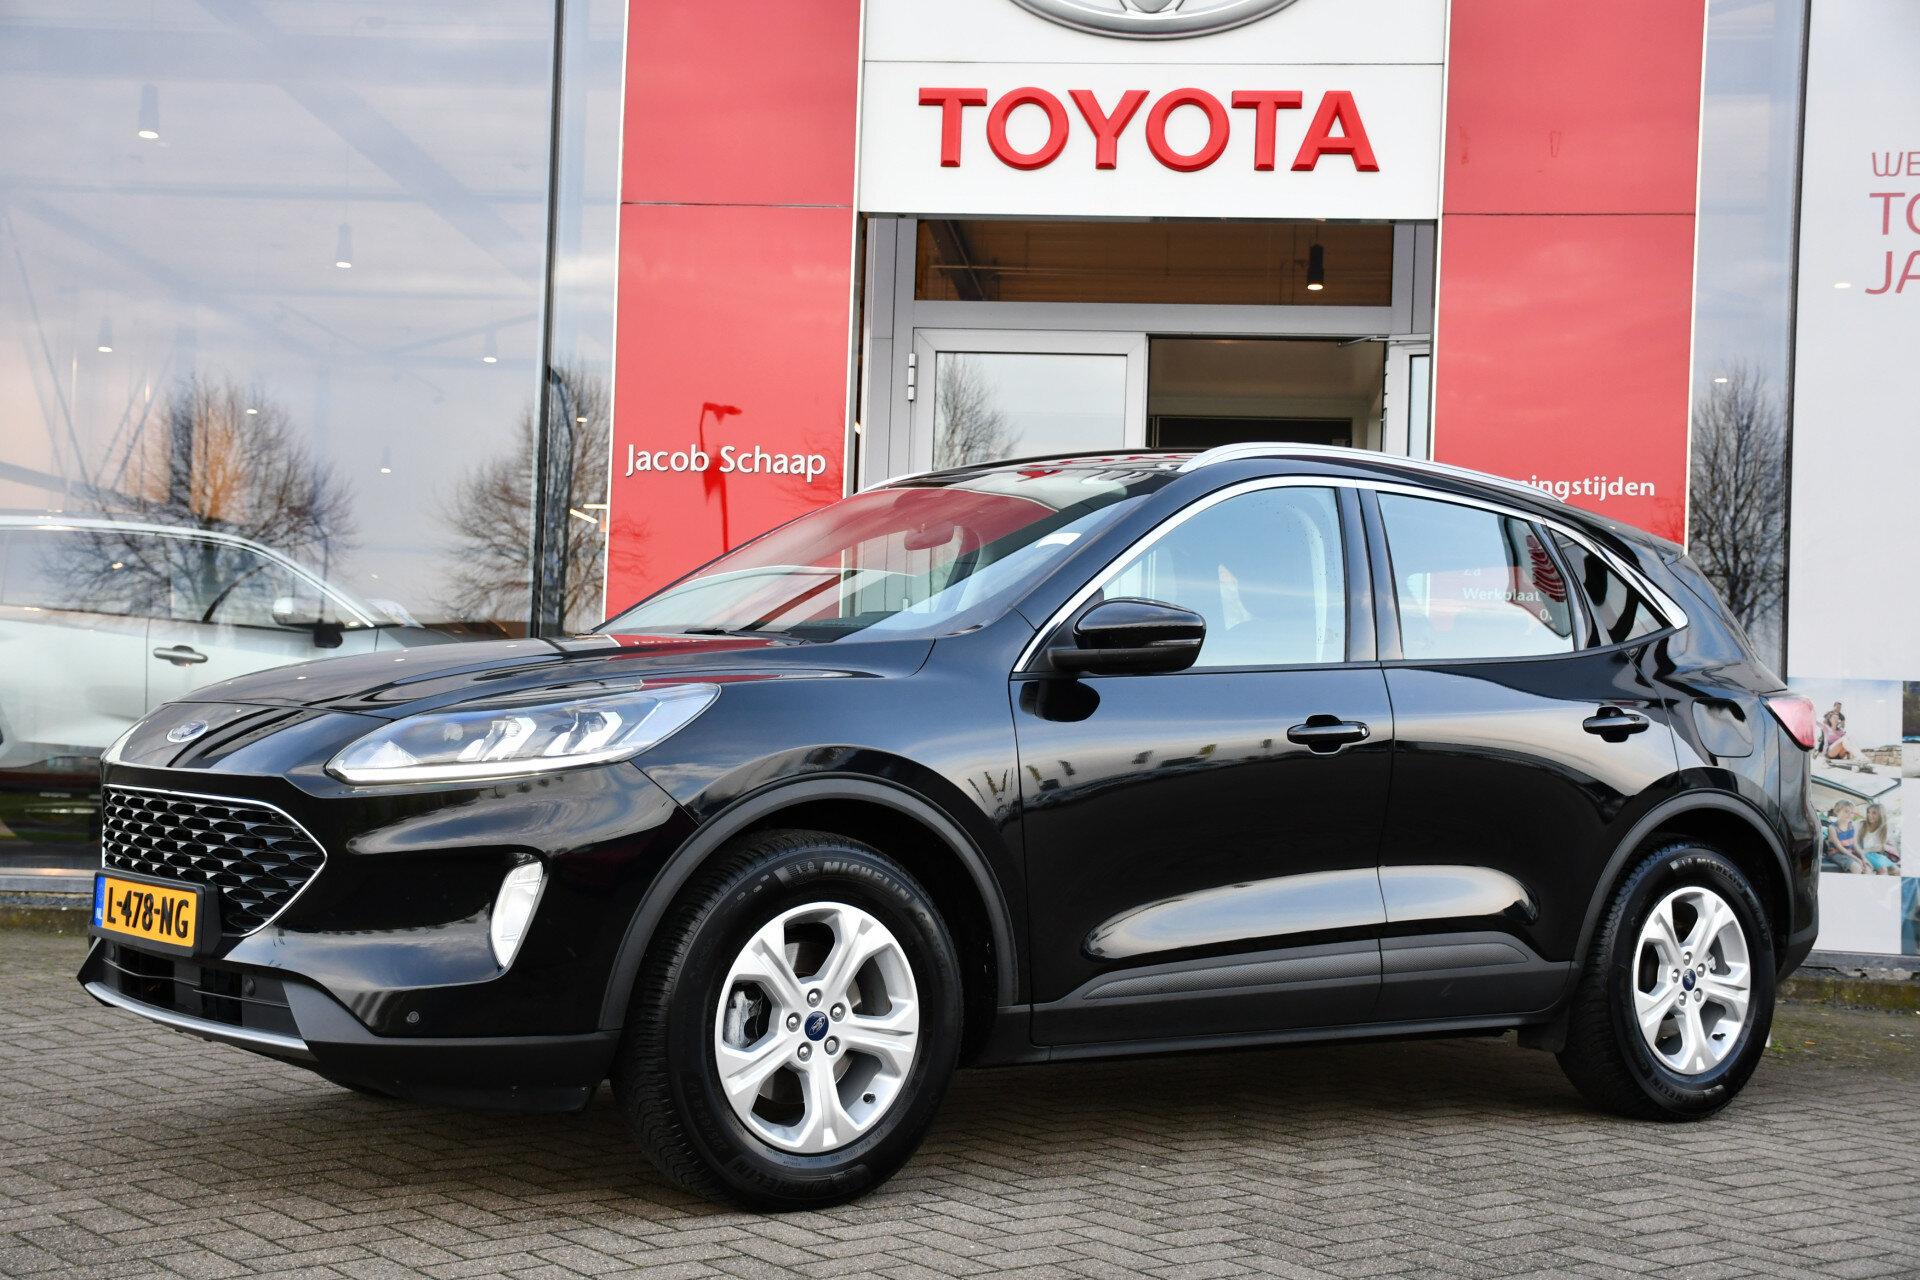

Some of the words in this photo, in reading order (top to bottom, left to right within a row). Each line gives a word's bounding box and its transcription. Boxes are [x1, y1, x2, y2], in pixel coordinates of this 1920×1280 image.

[919, 87, 1379, 172] TOYOTA
[626, 444, 709, 477] Jacob
[719, 445, 826, 483] Schaap
[823, 862, 910, 899] MICHELIN
[107, 887, 189, 938] L-478-NG
